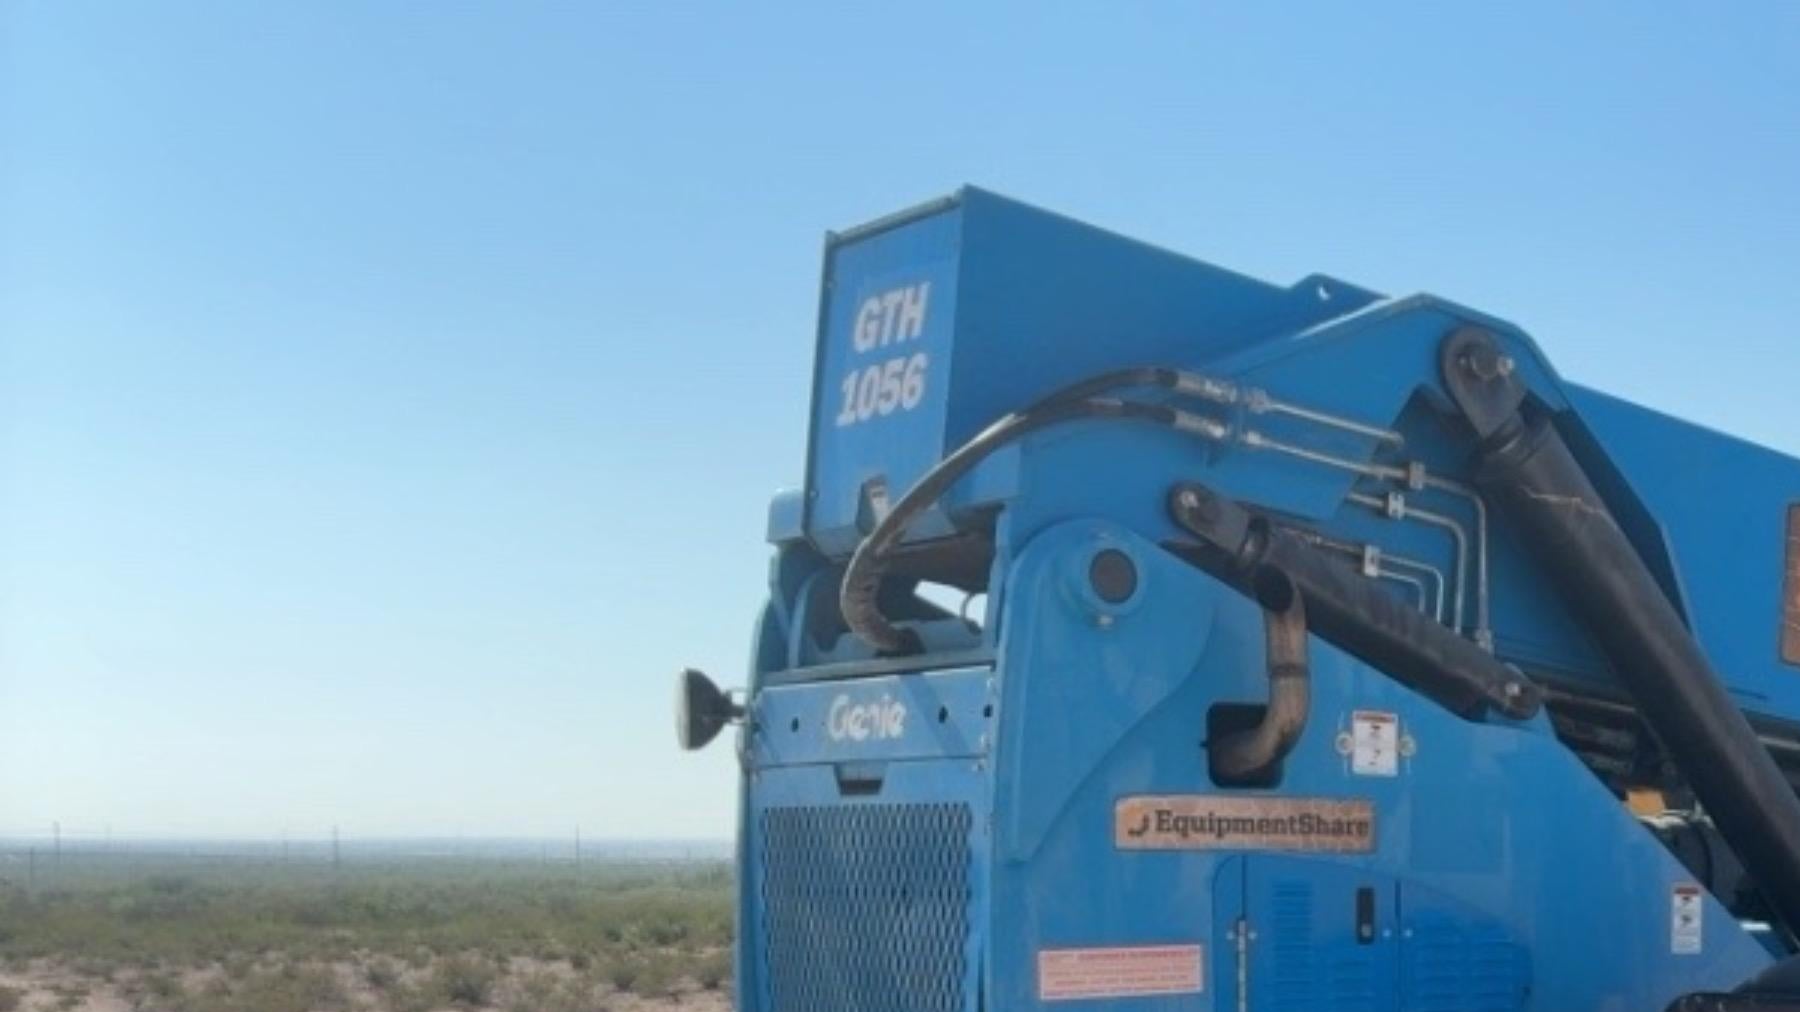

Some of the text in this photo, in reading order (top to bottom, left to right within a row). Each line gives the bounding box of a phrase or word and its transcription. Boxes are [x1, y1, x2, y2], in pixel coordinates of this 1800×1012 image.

[854, 281, 932, 353] GTH
[835, 353, 929, 427] 1056
[829, 692, 907, 741] Genie
[1154, 808, 1370, 838] EquipmentShare
